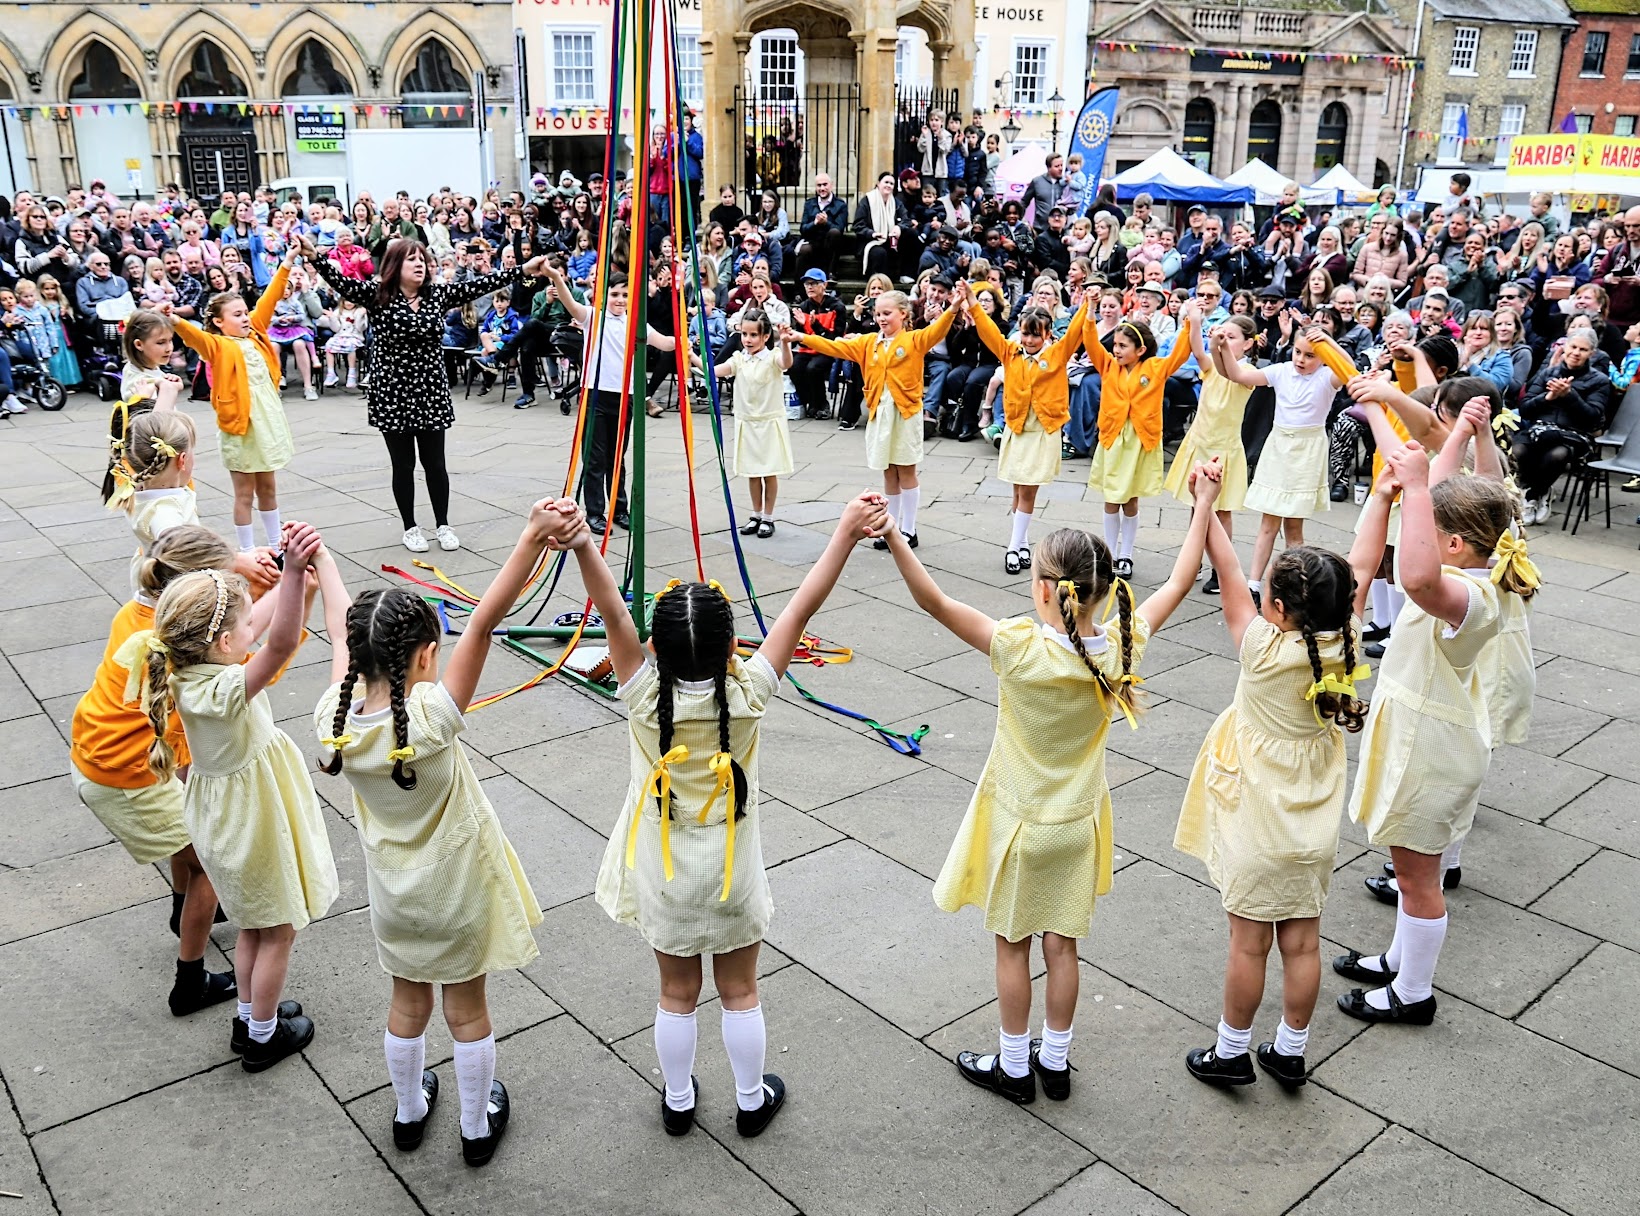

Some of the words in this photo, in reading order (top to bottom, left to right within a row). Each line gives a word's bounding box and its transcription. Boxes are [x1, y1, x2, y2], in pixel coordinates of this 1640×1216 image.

[997, 8, 1043, 21] HOUSE
[536, 117, 612, 130] HOUSE
[307, 141, 320, 149] TO
[321, 141, 337, 150] LET
[1513, 144, 1575, 166] HARIBO
[1083, 173, 1096, 206] ACTION
